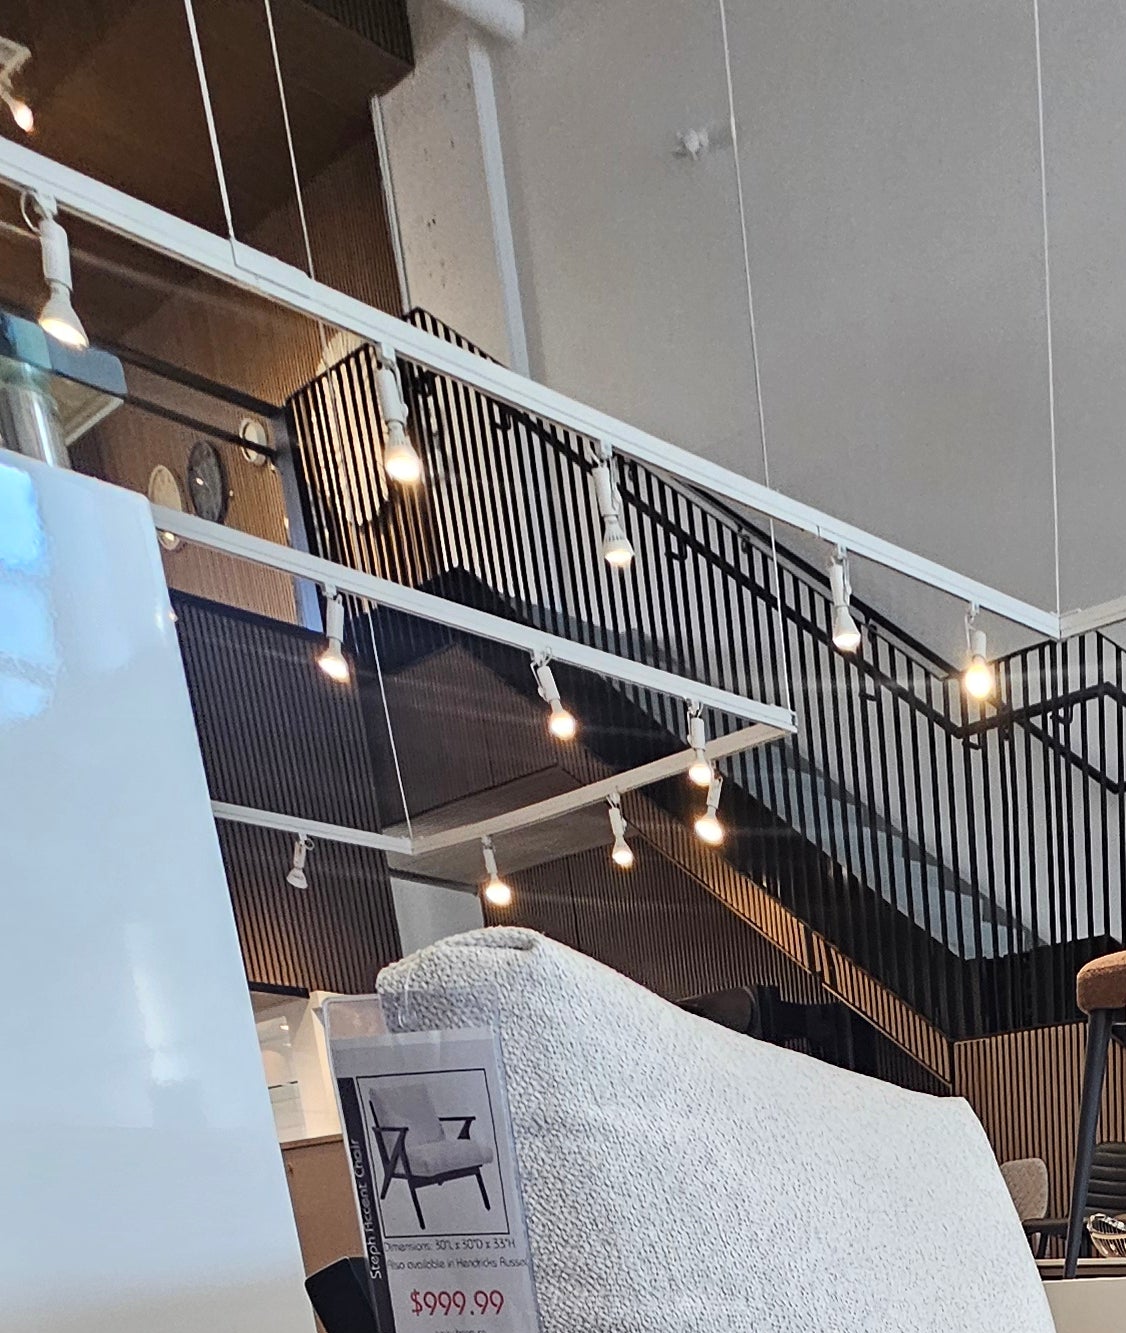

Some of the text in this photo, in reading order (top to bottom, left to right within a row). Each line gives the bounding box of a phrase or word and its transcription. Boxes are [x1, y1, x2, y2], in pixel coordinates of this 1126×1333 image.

[351, 1139, 382, 1280] Steph Accent Chair
[407, 1258, 446, 1270] available
[410, 1288, 505, 1316] $999.99
